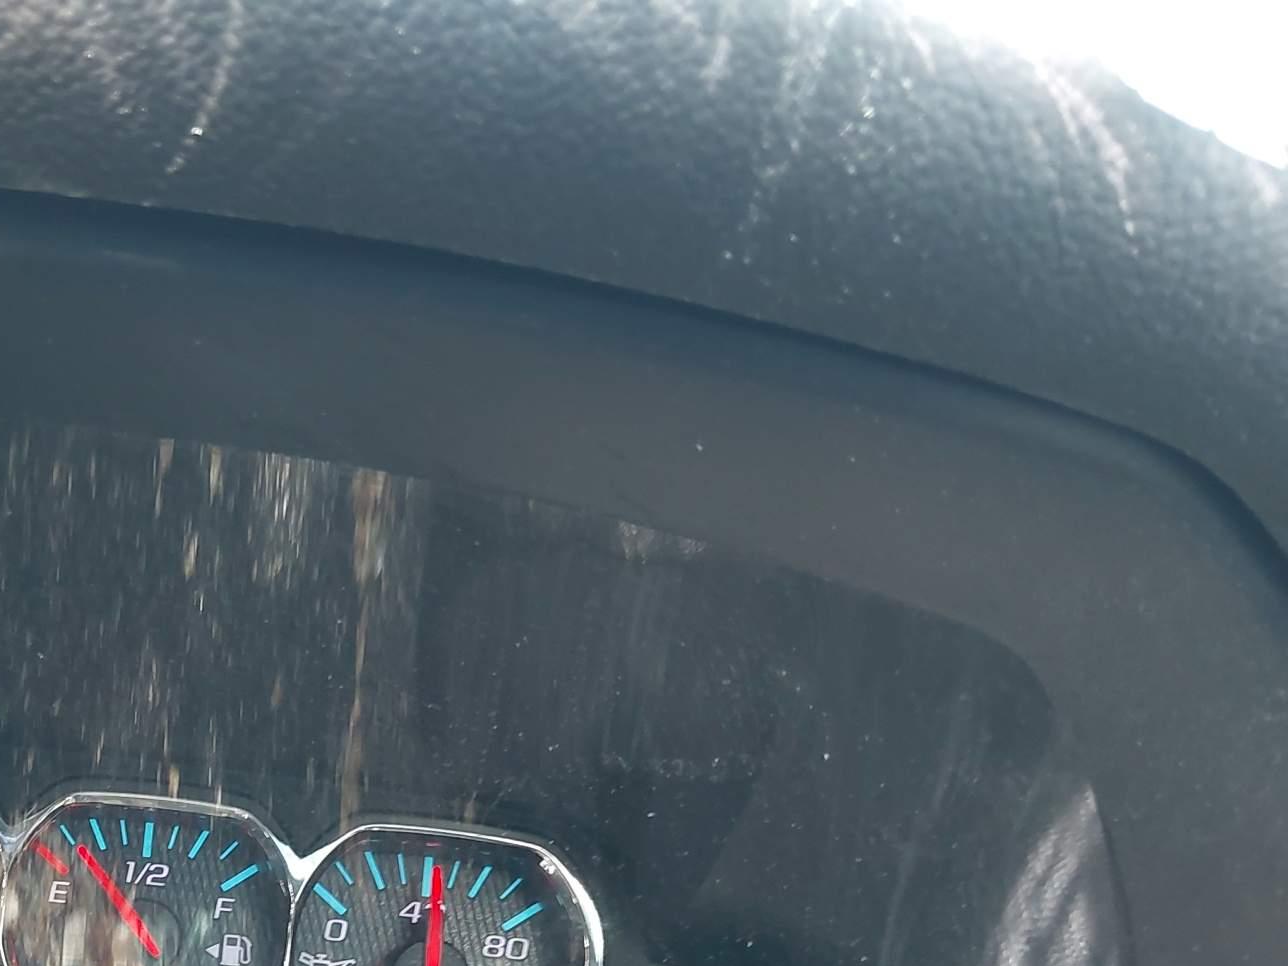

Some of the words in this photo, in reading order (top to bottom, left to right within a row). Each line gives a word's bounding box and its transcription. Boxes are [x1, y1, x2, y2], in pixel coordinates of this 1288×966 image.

[124, 859, 169, 887] 1/2
[48, 880, 70, 905] E
[214, 897, 235, 921] F
[324, 919, 348, 942] 0
[481, 935, 530, 961] 80
